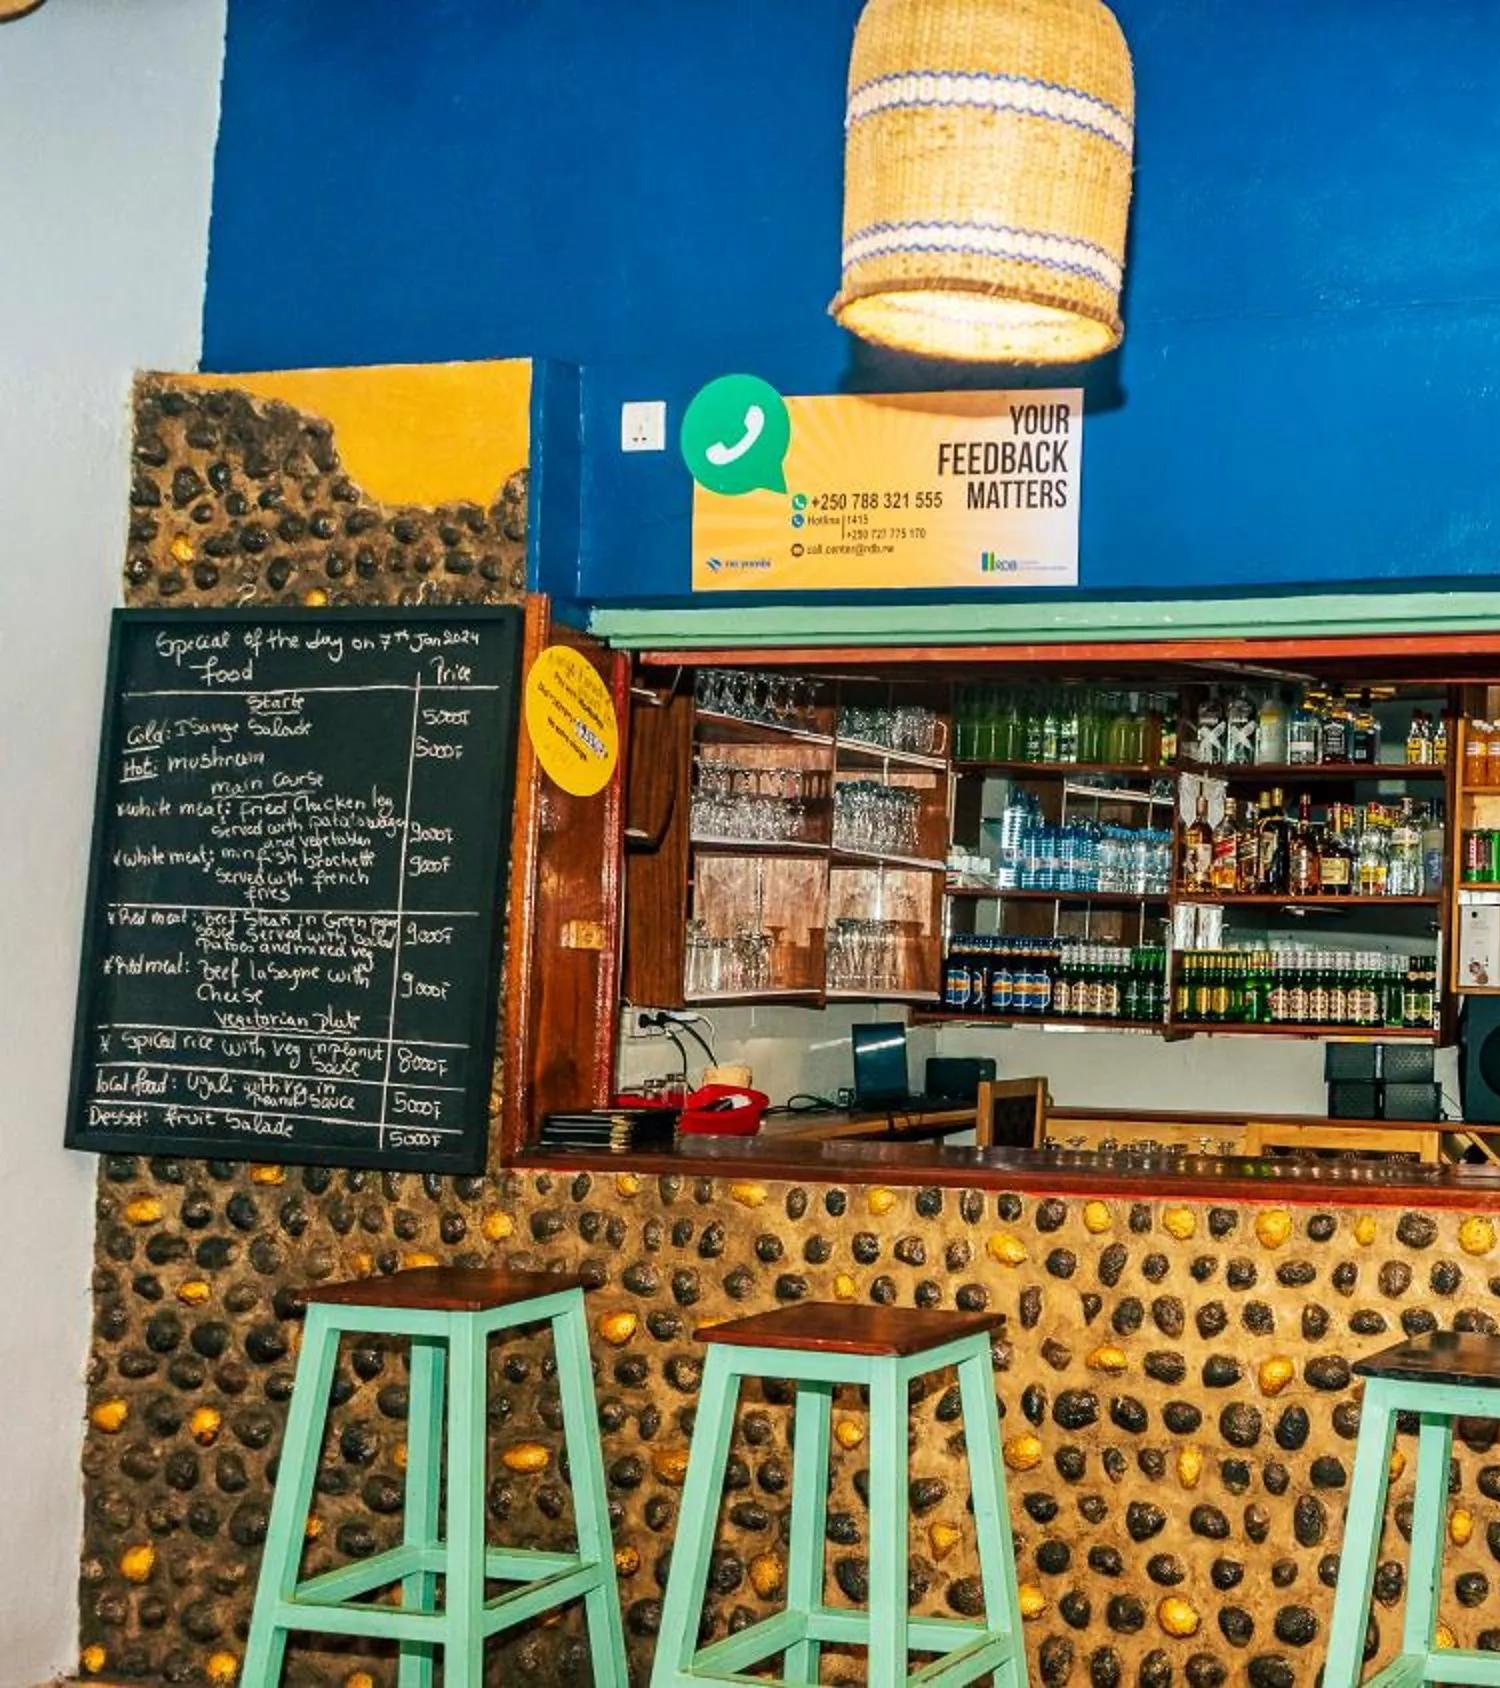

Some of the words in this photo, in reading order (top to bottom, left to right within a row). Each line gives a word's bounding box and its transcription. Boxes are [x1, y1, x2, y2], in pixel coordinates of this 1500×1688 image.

[1009, 404, 1070, 435] YOUR
[938, 440, 1068, 476] FEEDBACK
[811, 493, 847, 511] +250
[851, 492, 879, 510] 788
[883, 491, 910, 509] 321
[915, 491, 943, 509] 555
[967, 479, 1067, 510] MATTERS
[807, 515, 840, 526] Hotline
[155, 631, 231, 667] Special
[243, 627, 263, 658] of
[266, 628, 300, 650] the
[305, 628, 343, 663] day
[351, 637, 375, 650] on
[409, 632, 441, 653] Jan
[442, 629, 480, 646] 2024
[429, 655, 471, 685] Price
[267, 812, 303, 834] with
[267, 869, 303, 888] with
[183, 1035, 214, 1051] rice
[221, 1035, 265, 1058] with
[317, 1081, 336, 1095] in
